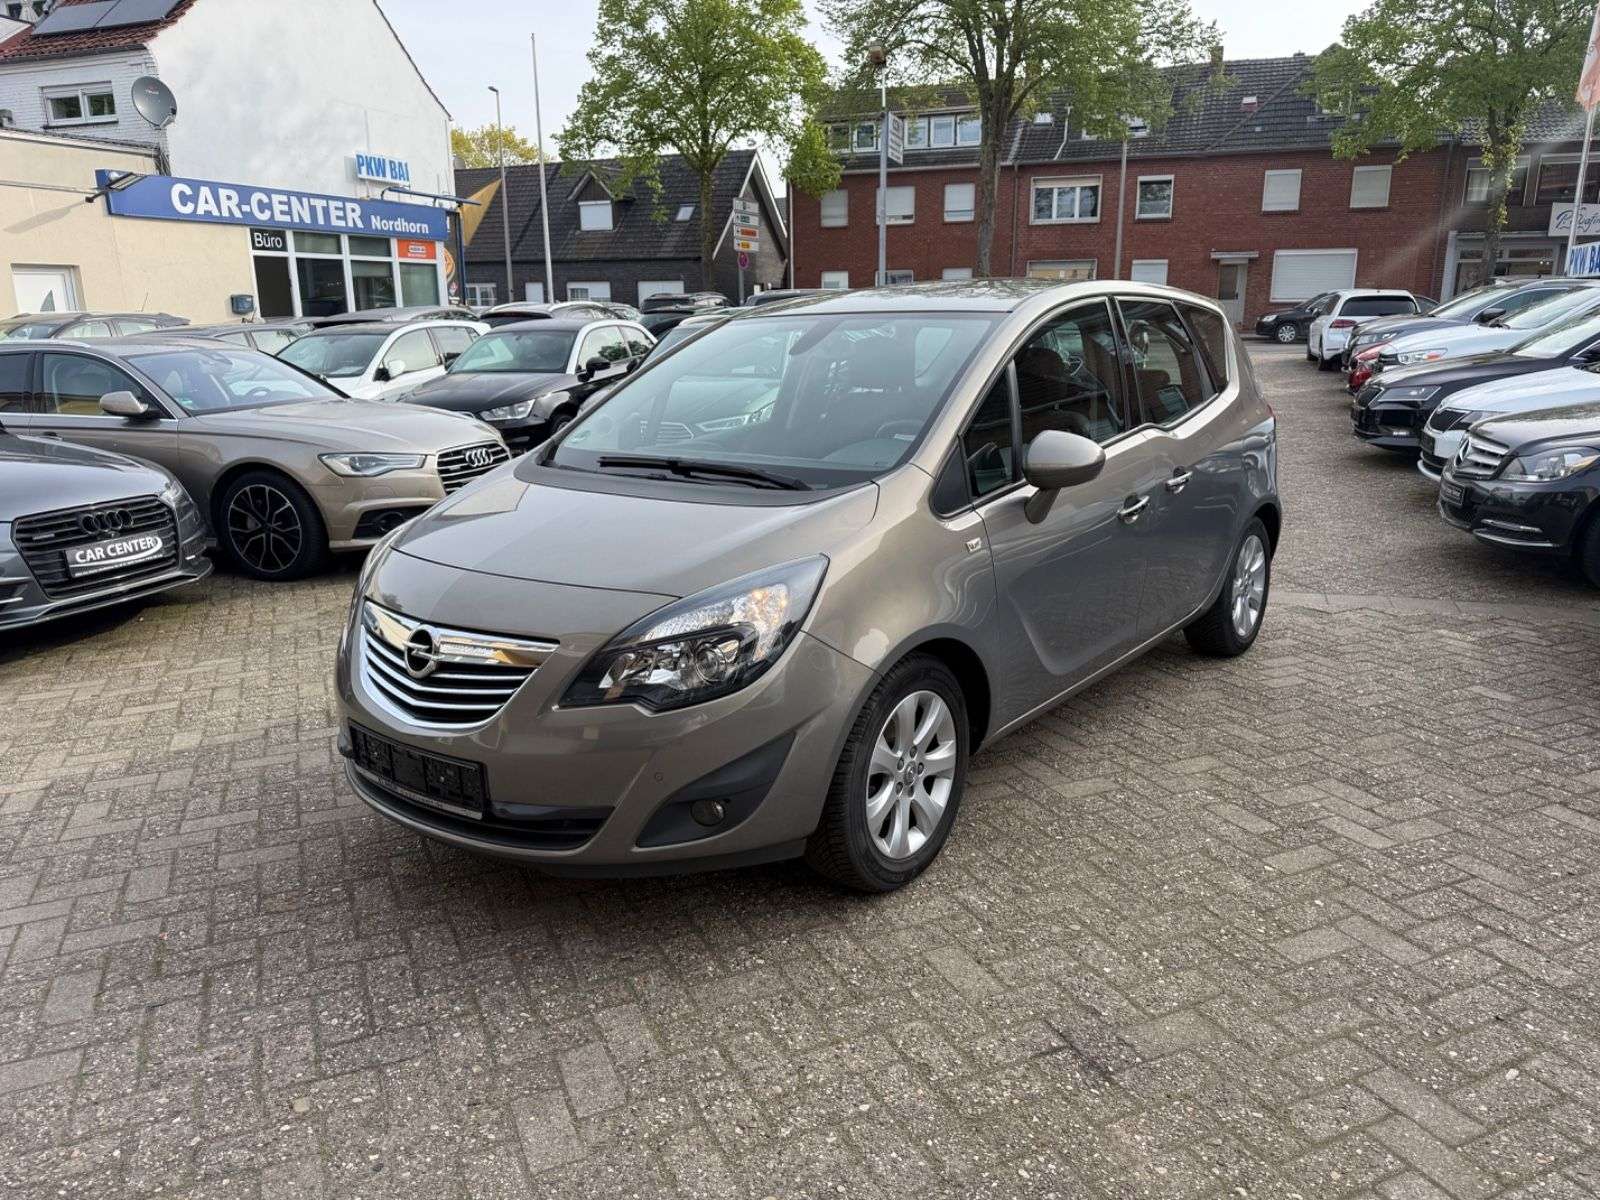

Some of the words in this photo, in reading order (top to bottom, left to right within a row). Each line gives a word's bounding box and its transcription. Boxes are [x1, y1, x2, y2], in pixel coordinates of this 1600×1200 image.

[356, 154, 387, 178] PKW
[171, 183, 364, 228] CAR-CENTER
[371, 214, 429, 234] Nordhorn
[254, 232, 282, 248] Büro
[75, 547, 105, 562] CAR
[107, 536, 155, 556] CENTER
